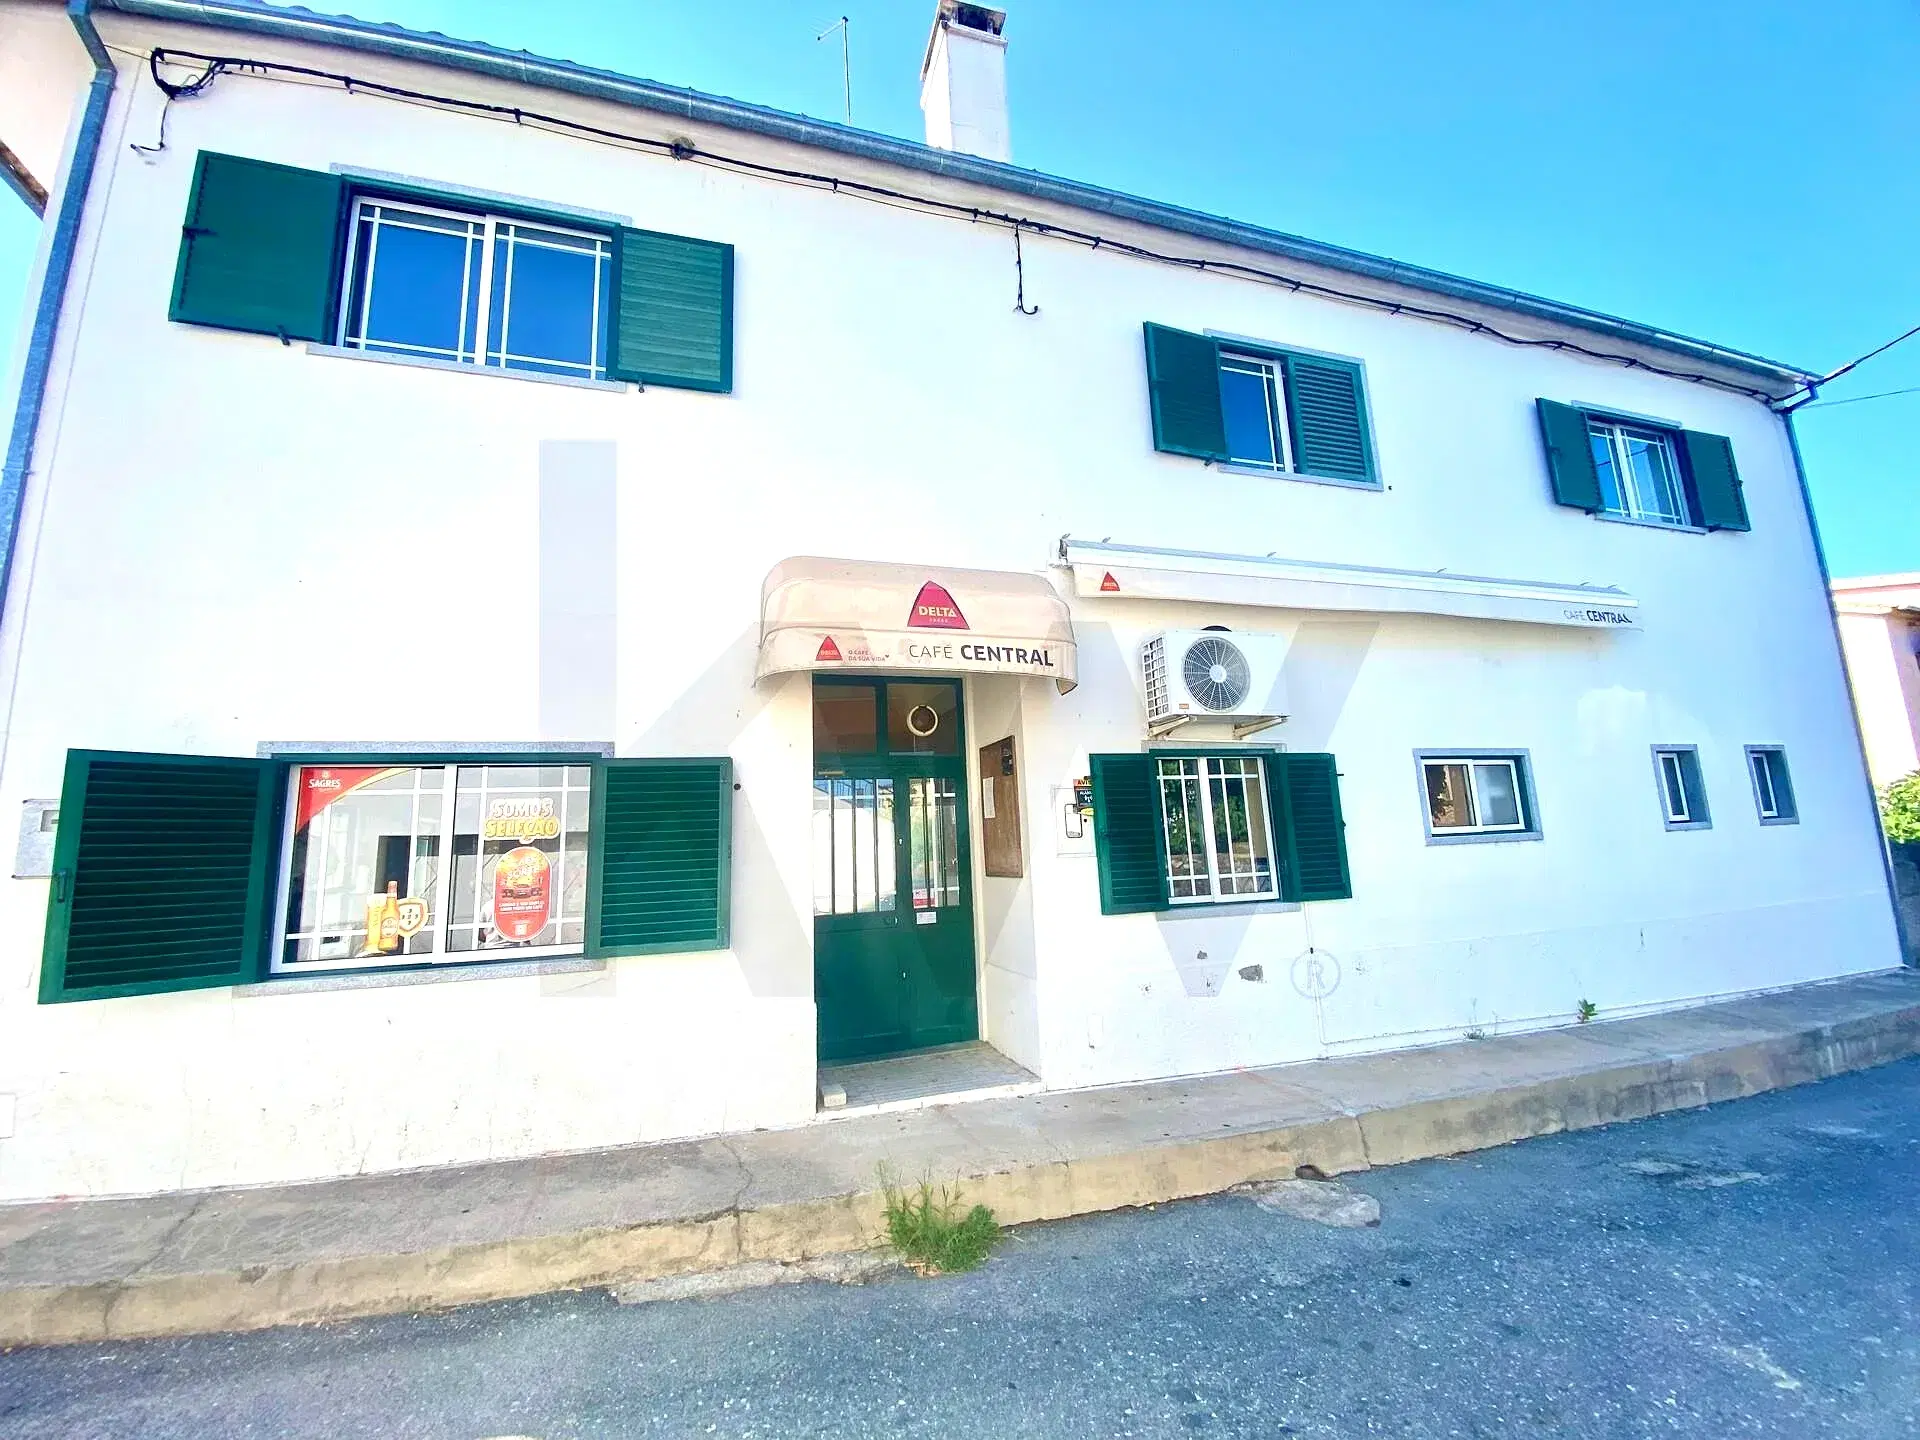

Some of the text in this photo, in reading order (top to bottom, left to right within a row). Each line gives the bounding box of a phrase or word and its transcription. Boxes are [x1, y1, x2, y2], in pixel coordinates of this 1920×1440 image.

[918, 605, 957, 617] DELTA
[1586, 610, 1632, 624] CENTRAL
[908, 643, 1054, 667] CAFÉ CENTRAL
[308, 778, 341, 789] SAGRES
[492, 799, 554, 818] SOMOS
